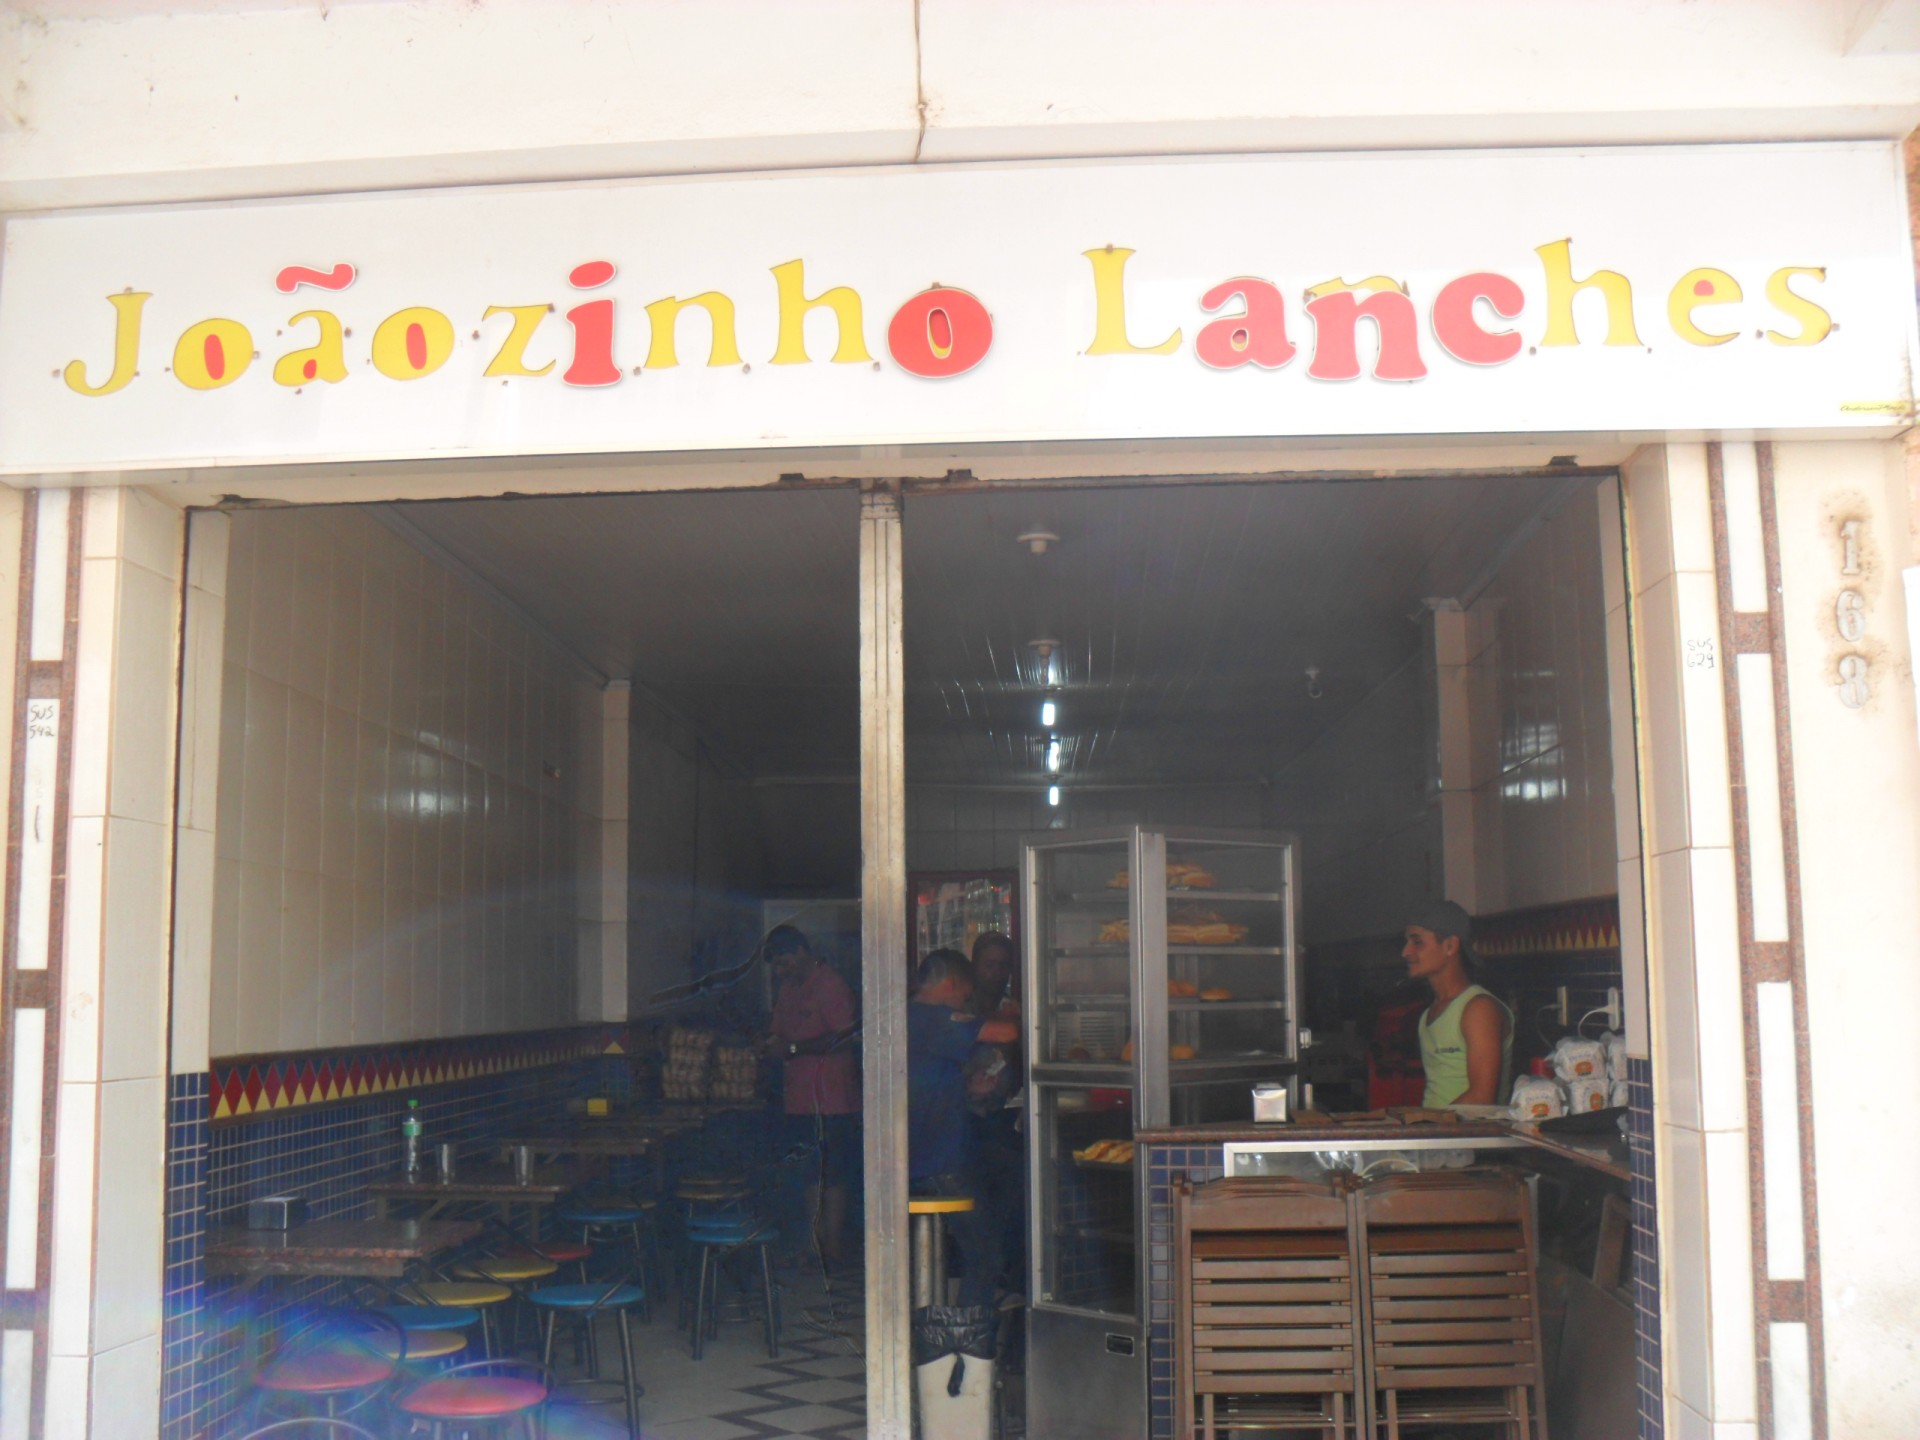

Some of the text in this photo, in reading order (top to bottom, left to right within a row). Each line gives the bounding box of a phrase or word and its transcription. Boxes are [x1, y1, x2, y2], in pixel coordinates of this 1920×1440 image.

[63, 238, 1833, 397] Joãozinho Lanches
[1835, 519, 1869, 709] 168
[30, 704, 54, 722] SUS
